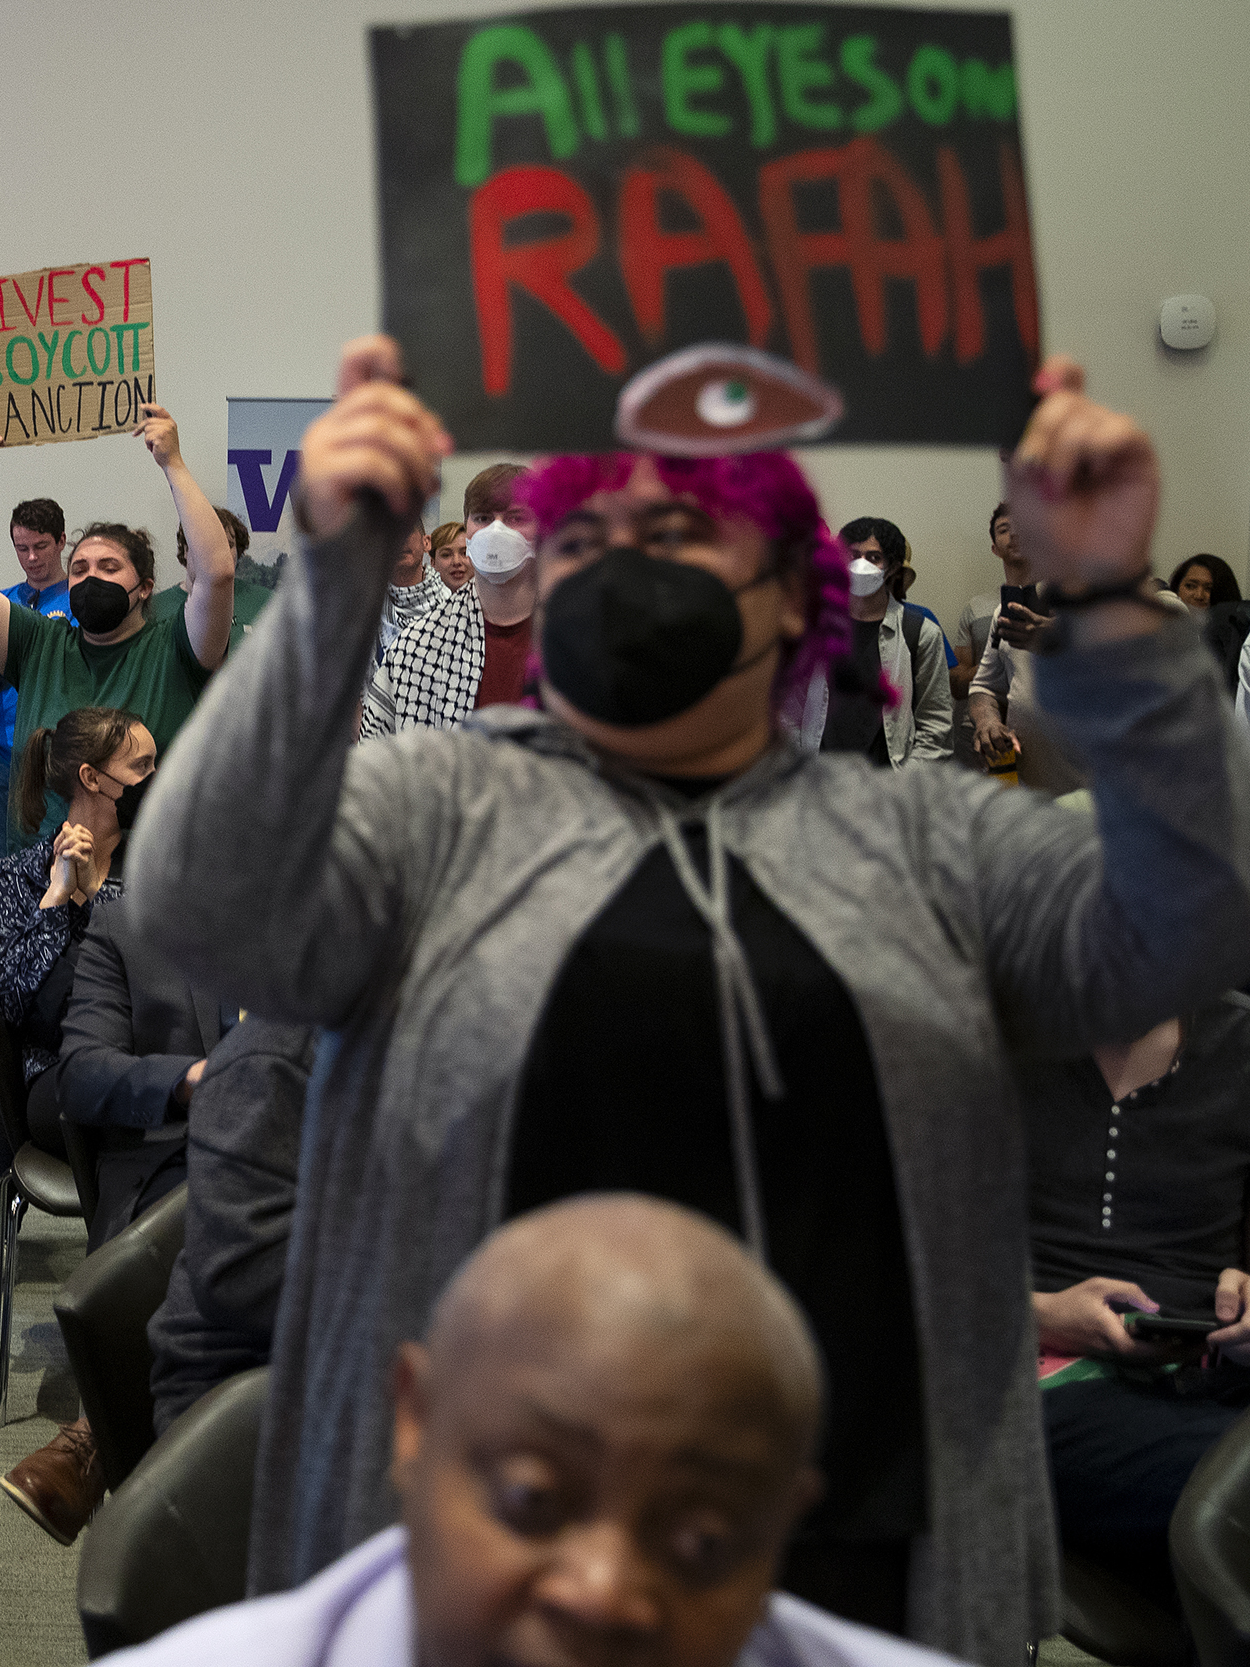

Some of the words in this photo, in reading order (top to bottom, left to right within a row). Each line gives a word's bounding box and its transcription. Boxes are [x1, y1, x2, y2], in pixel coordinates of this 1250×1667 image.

[455, 25, 640, 186] All
[662, 22, 903, 147] EYES
[469, 137, 1040, 394] RAFAH
